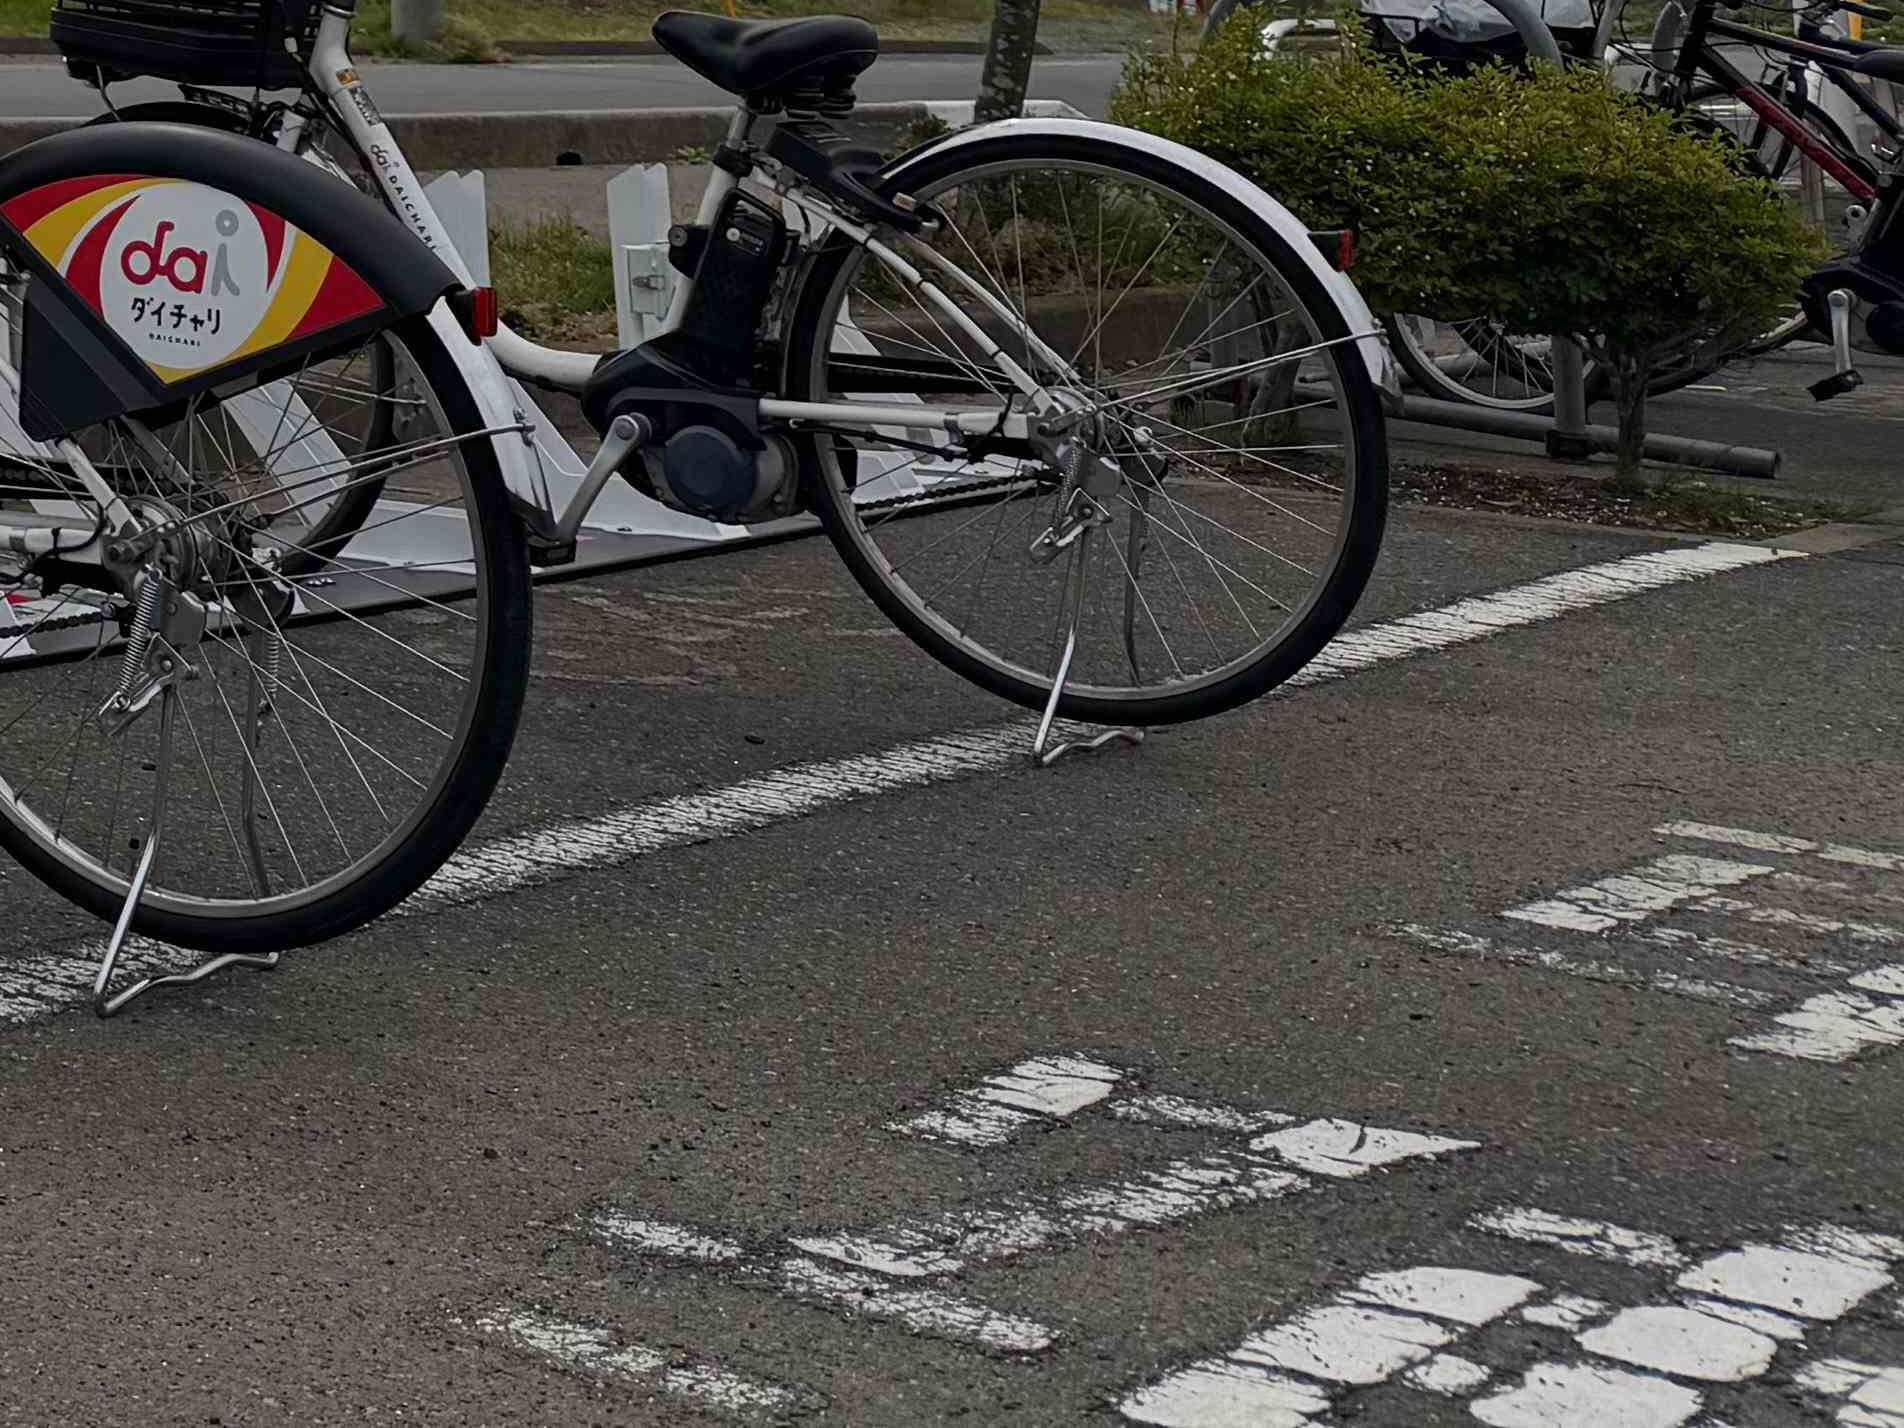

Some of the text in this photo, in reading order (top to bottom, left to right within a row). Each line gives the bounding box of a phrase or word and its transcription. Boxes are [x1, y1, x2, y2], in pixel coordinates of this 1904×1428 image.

[120, 208, 241, 297] dai
[130, 297, 222, 335] ダイチャリ
